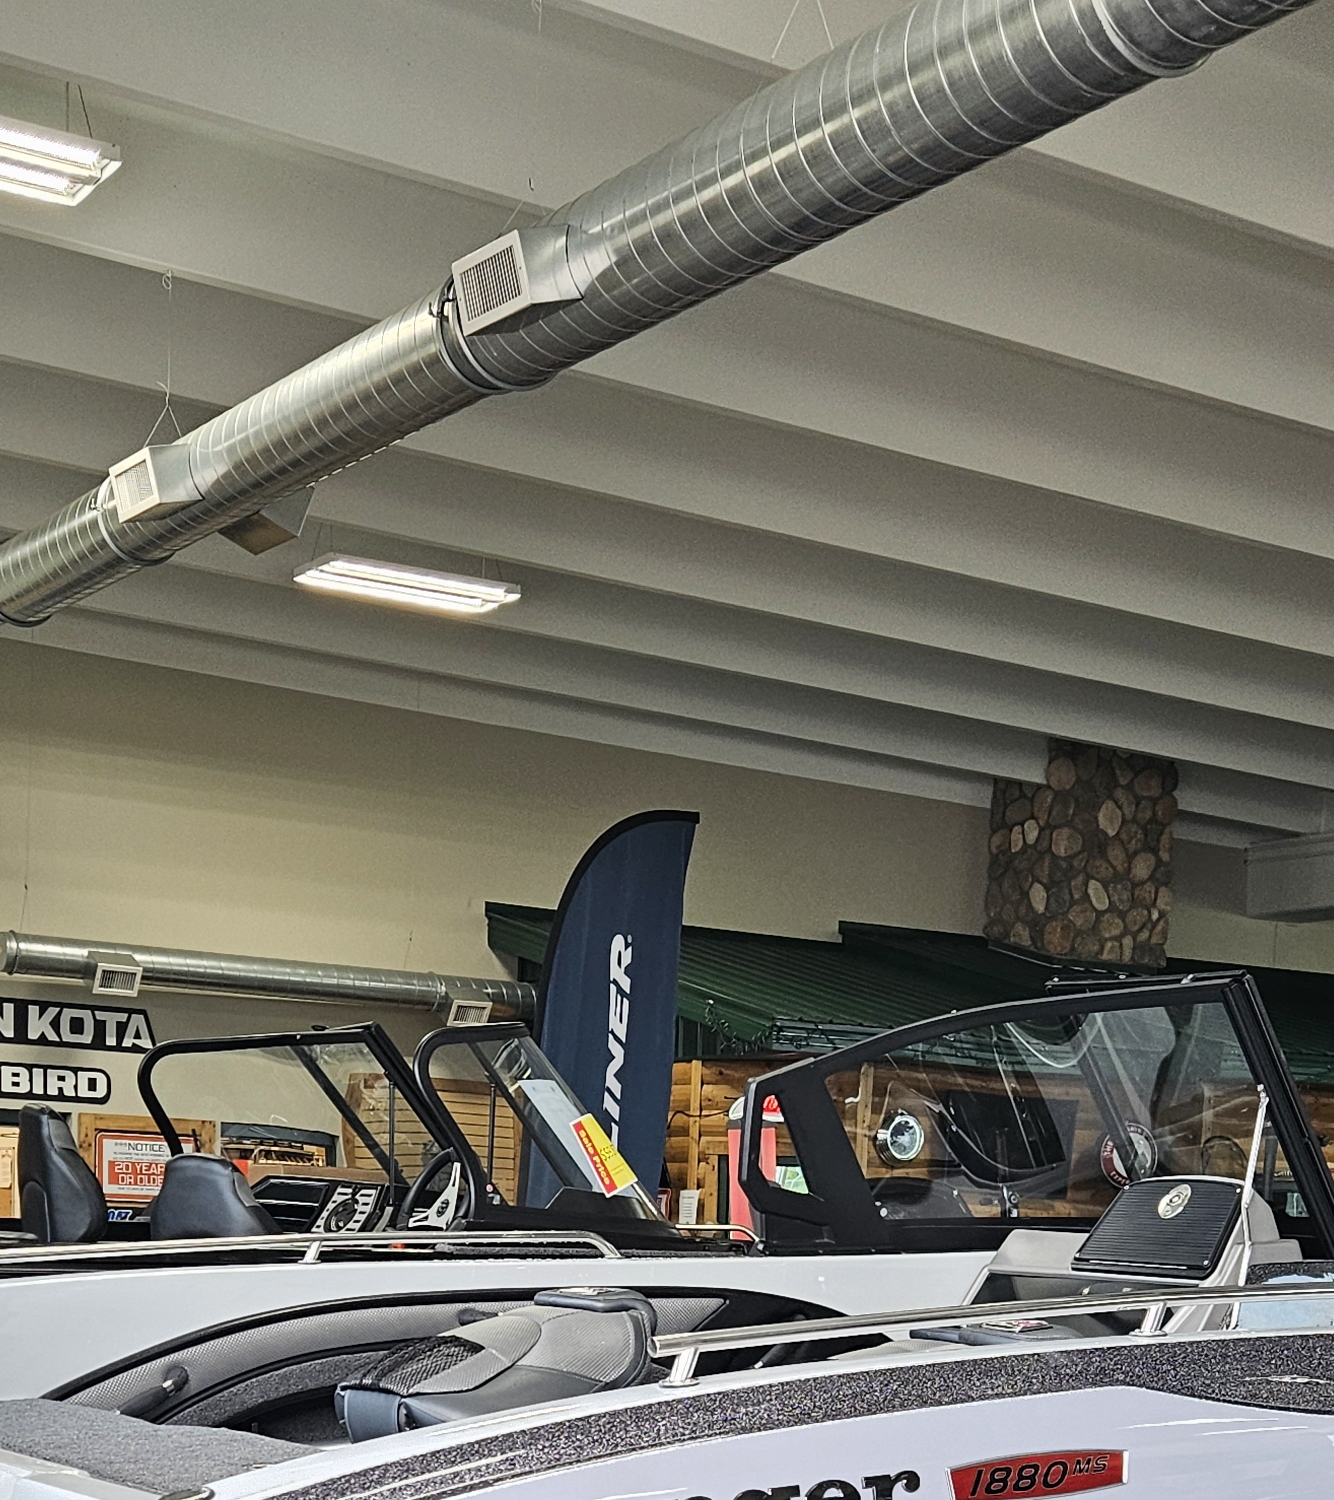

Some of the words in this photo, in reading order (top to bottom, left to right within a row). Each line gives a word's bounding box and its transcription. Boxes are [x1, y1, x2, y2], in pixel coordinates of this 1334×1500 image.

[27, 1004, 154, 1049] KOTA
[127, 1142, 166, 1153] NOTICE
[579, 1129, 595, 1155] Sale
[592, 1155, 611, 1186] Price
[114, 1161, 132, 1174] 20
[118, 1173, 135, 1185] OR
[968, 1461, 1068, 1498] 1880
[1071, 1455, 1110, 1476] MS
